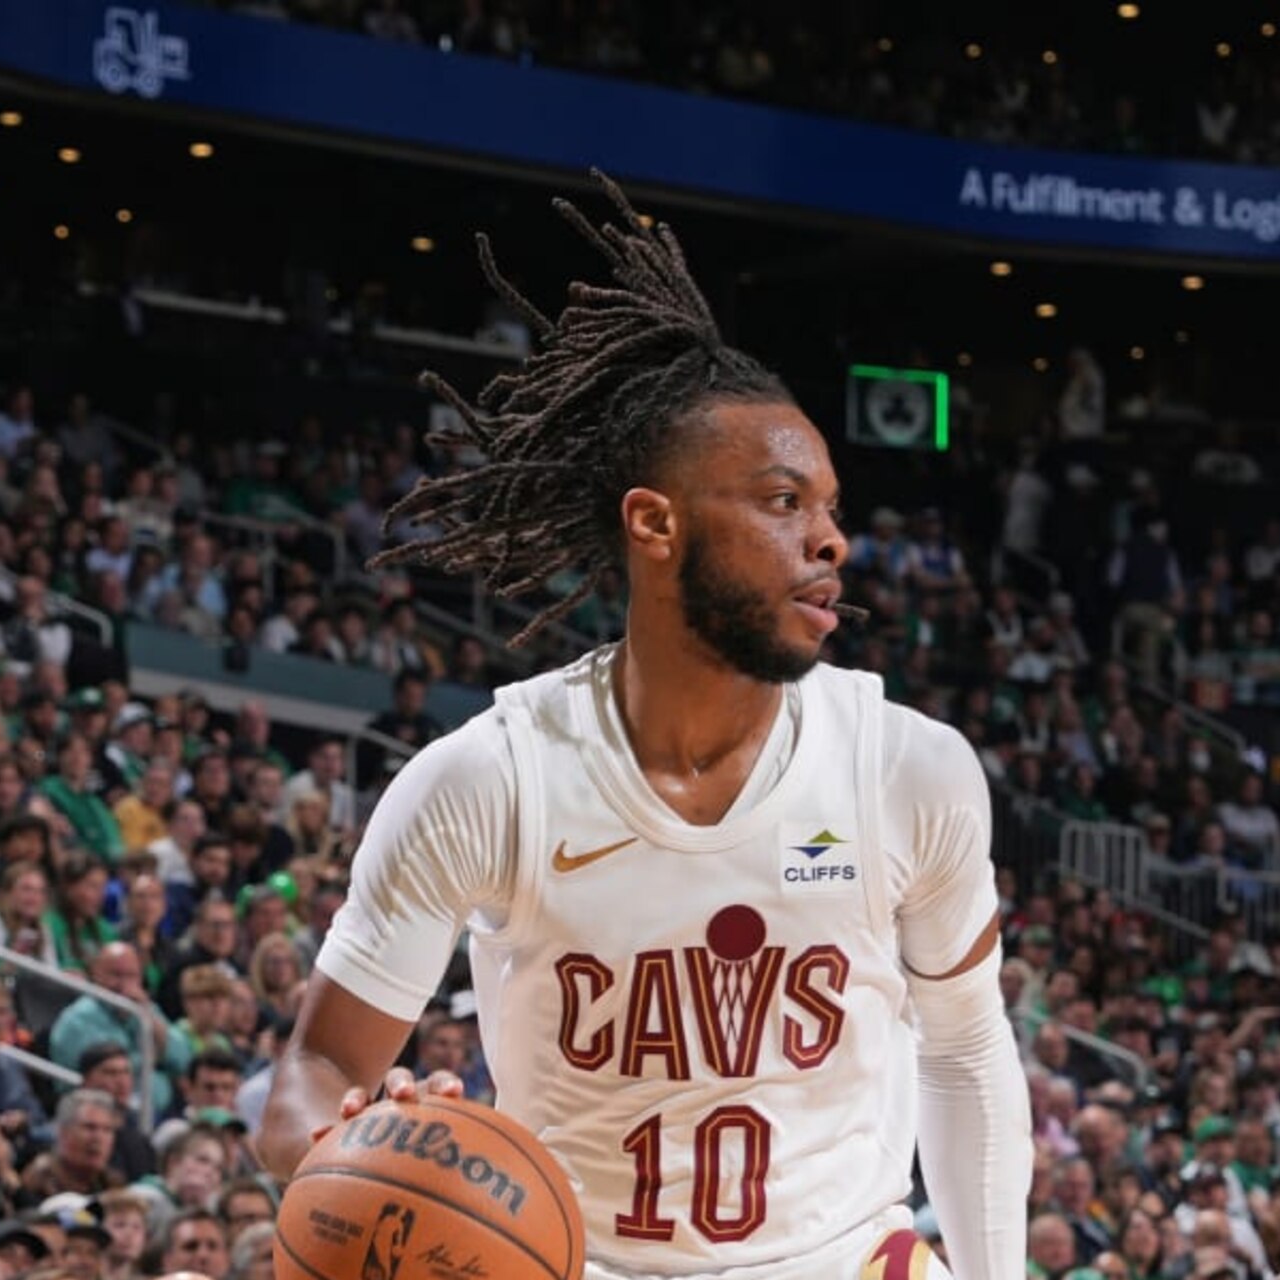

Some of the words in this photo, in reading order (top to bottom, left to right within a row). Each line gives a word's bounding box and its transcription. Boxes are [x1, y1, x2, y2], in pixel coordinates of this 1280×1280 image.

[959, 167, 987, 209] A
[991, 171, 1164, 225] Fulfillment
[1174, 187, 1203, 226] &
[784, 864, 856, 883] CLIFFS
[554, 944, 851, 1081] CAVS
[341, 1112, 527, 1218] Wilson
[615, 1104, 772, 1243] 10
